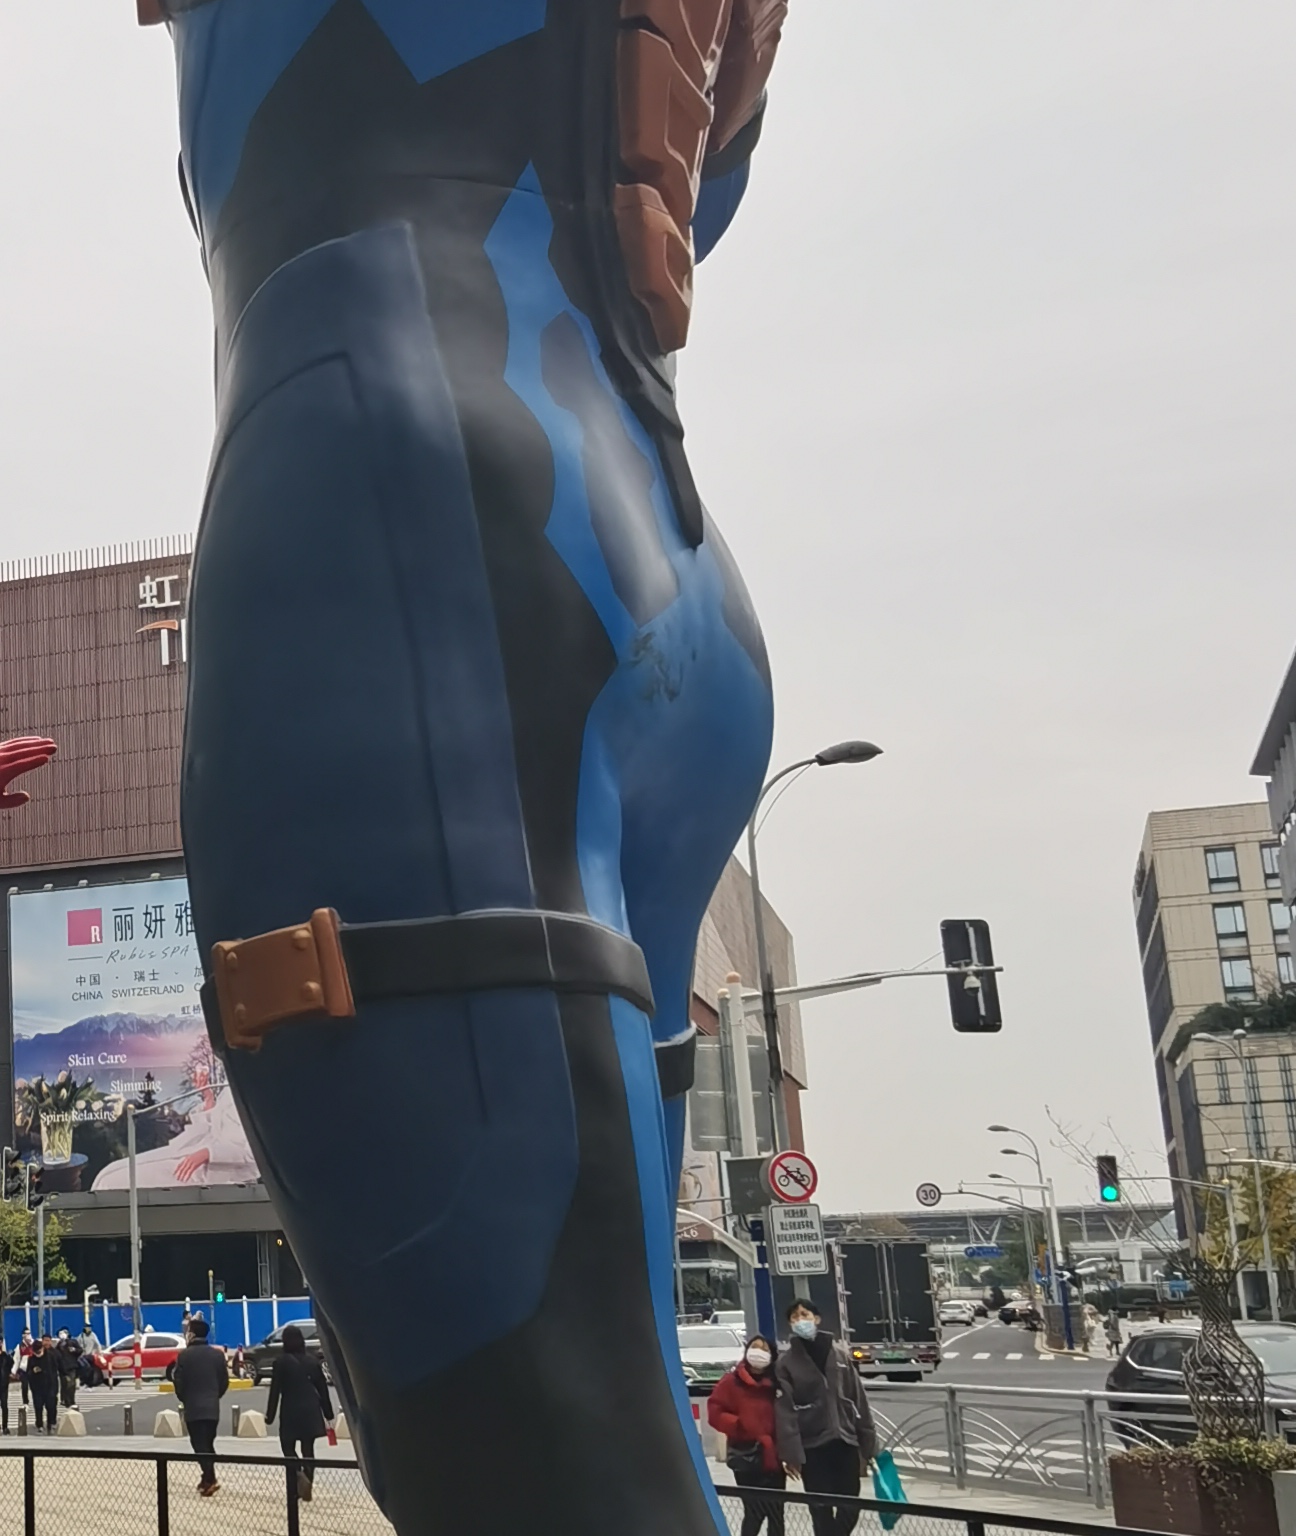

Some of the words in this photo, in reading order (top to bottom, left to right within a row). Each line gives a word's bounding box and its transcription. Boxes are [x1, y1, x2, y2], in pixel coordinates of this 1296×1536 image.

[138, 569, 191, 609] 虹
[90, 925, 102, 943] R
[162, 944, 190, 959] SPA
[75, 973, 101, 987] 中国
[133, 969, 160, 983] 瑞士
[71, 991, 103, 1002] CHINA
[111, 984, 185, 999] SWITZERLAND
[68, 1052, 95, 1067] Skin
[97, 1051, 128, 1065] Care
[110, 1079, 162, 1093] Slimming
[40, 1111, 69, 1126] Spirit
[71, 1109, 117, 1123] Relaxing
[921, 1189, 937, 1200] 30
